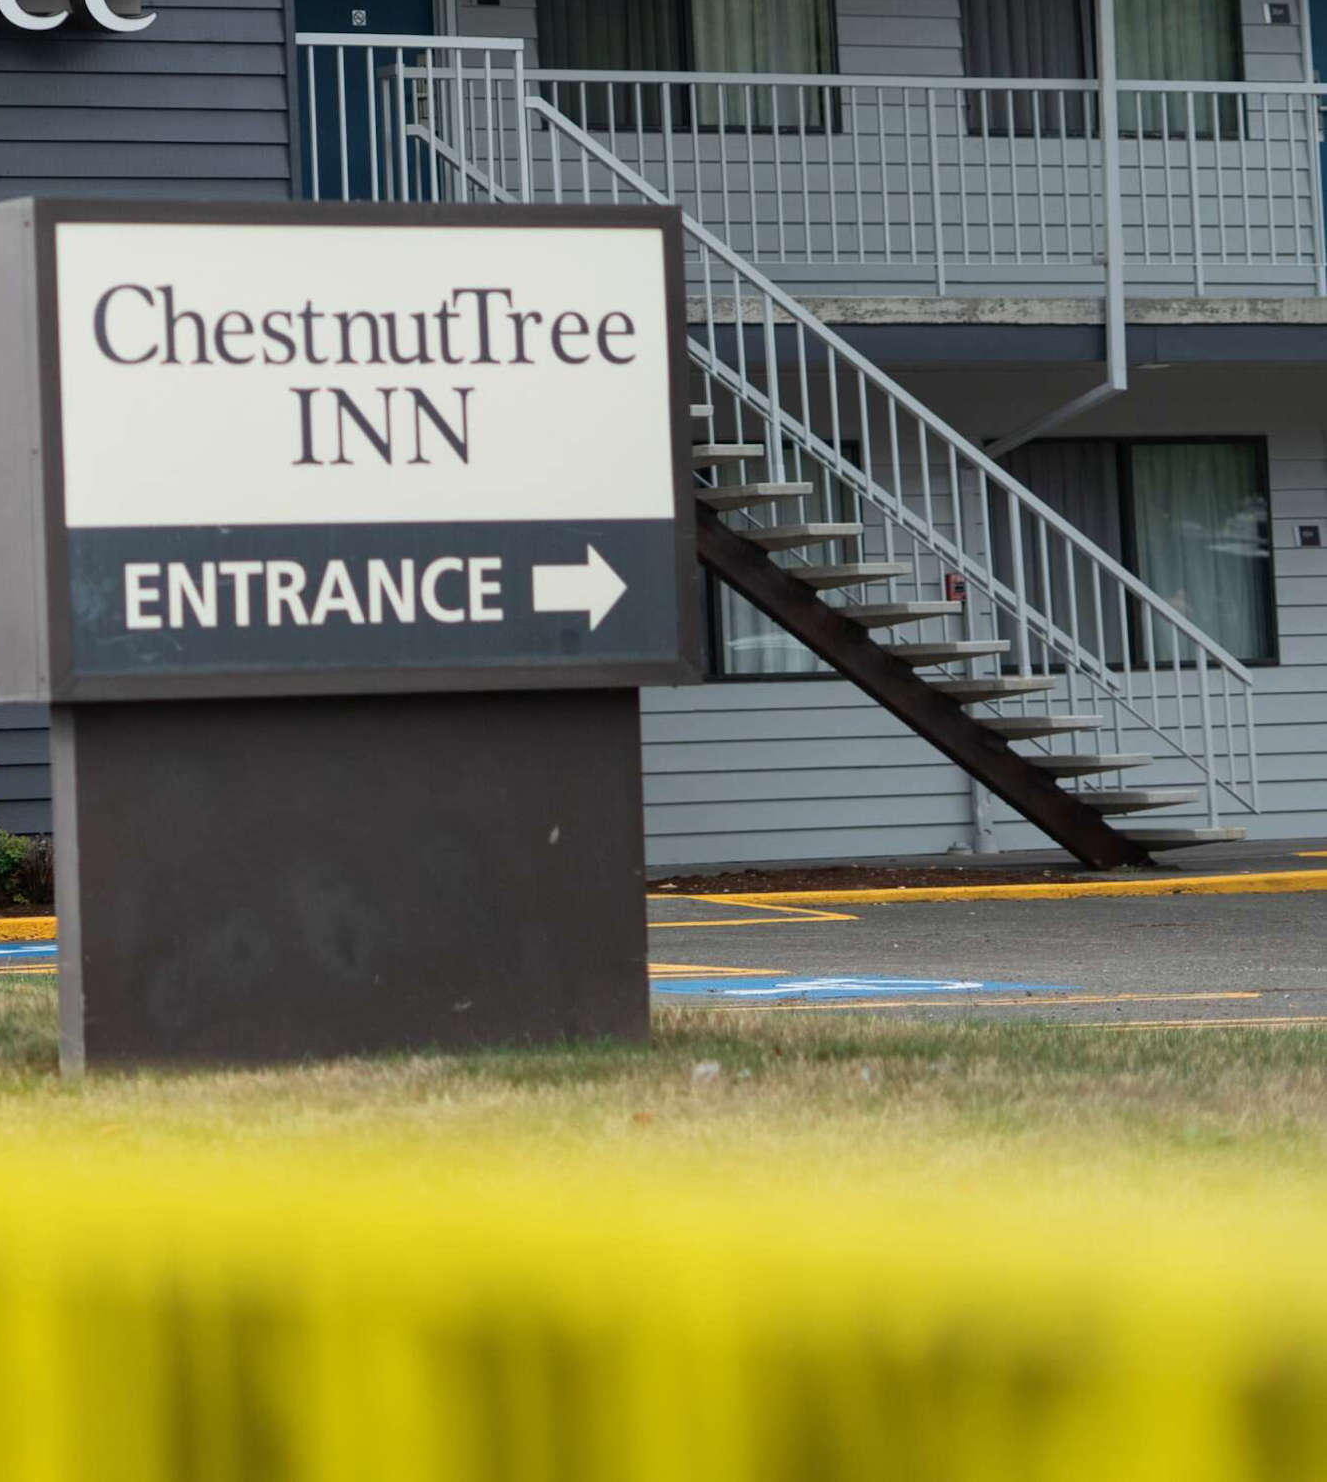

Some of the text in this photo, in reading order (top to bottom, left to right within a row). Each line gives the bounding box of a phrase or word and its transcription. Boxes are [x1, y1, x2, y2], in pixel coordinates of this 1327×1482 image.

[92, 283, 637, 366] ChestnutTree
[288, 386, 476, 467] INN
[123, 555, 505, 631] ENTRANCE
